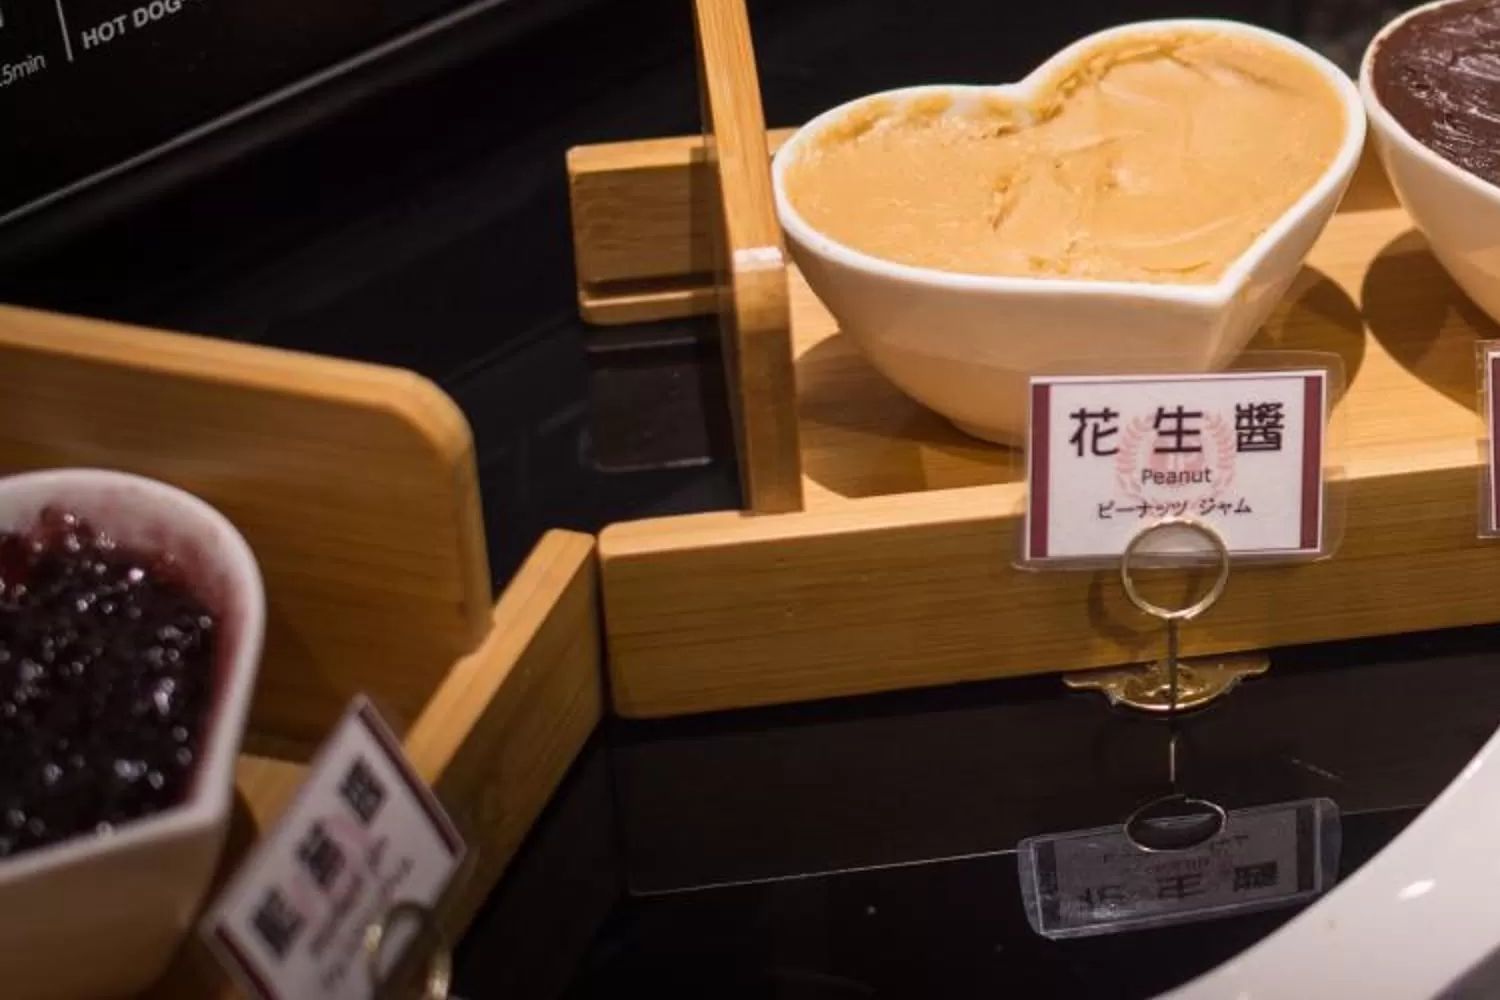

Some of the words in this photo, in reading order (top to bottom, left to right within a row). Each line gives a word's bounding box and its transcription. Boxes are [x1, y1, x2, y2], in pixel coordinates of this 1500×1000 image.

[81, 13, 128, 49] HOT
[1069, 402, 1286, 458] 花生醬
[1141, 467, 1212, 485] Peanut
